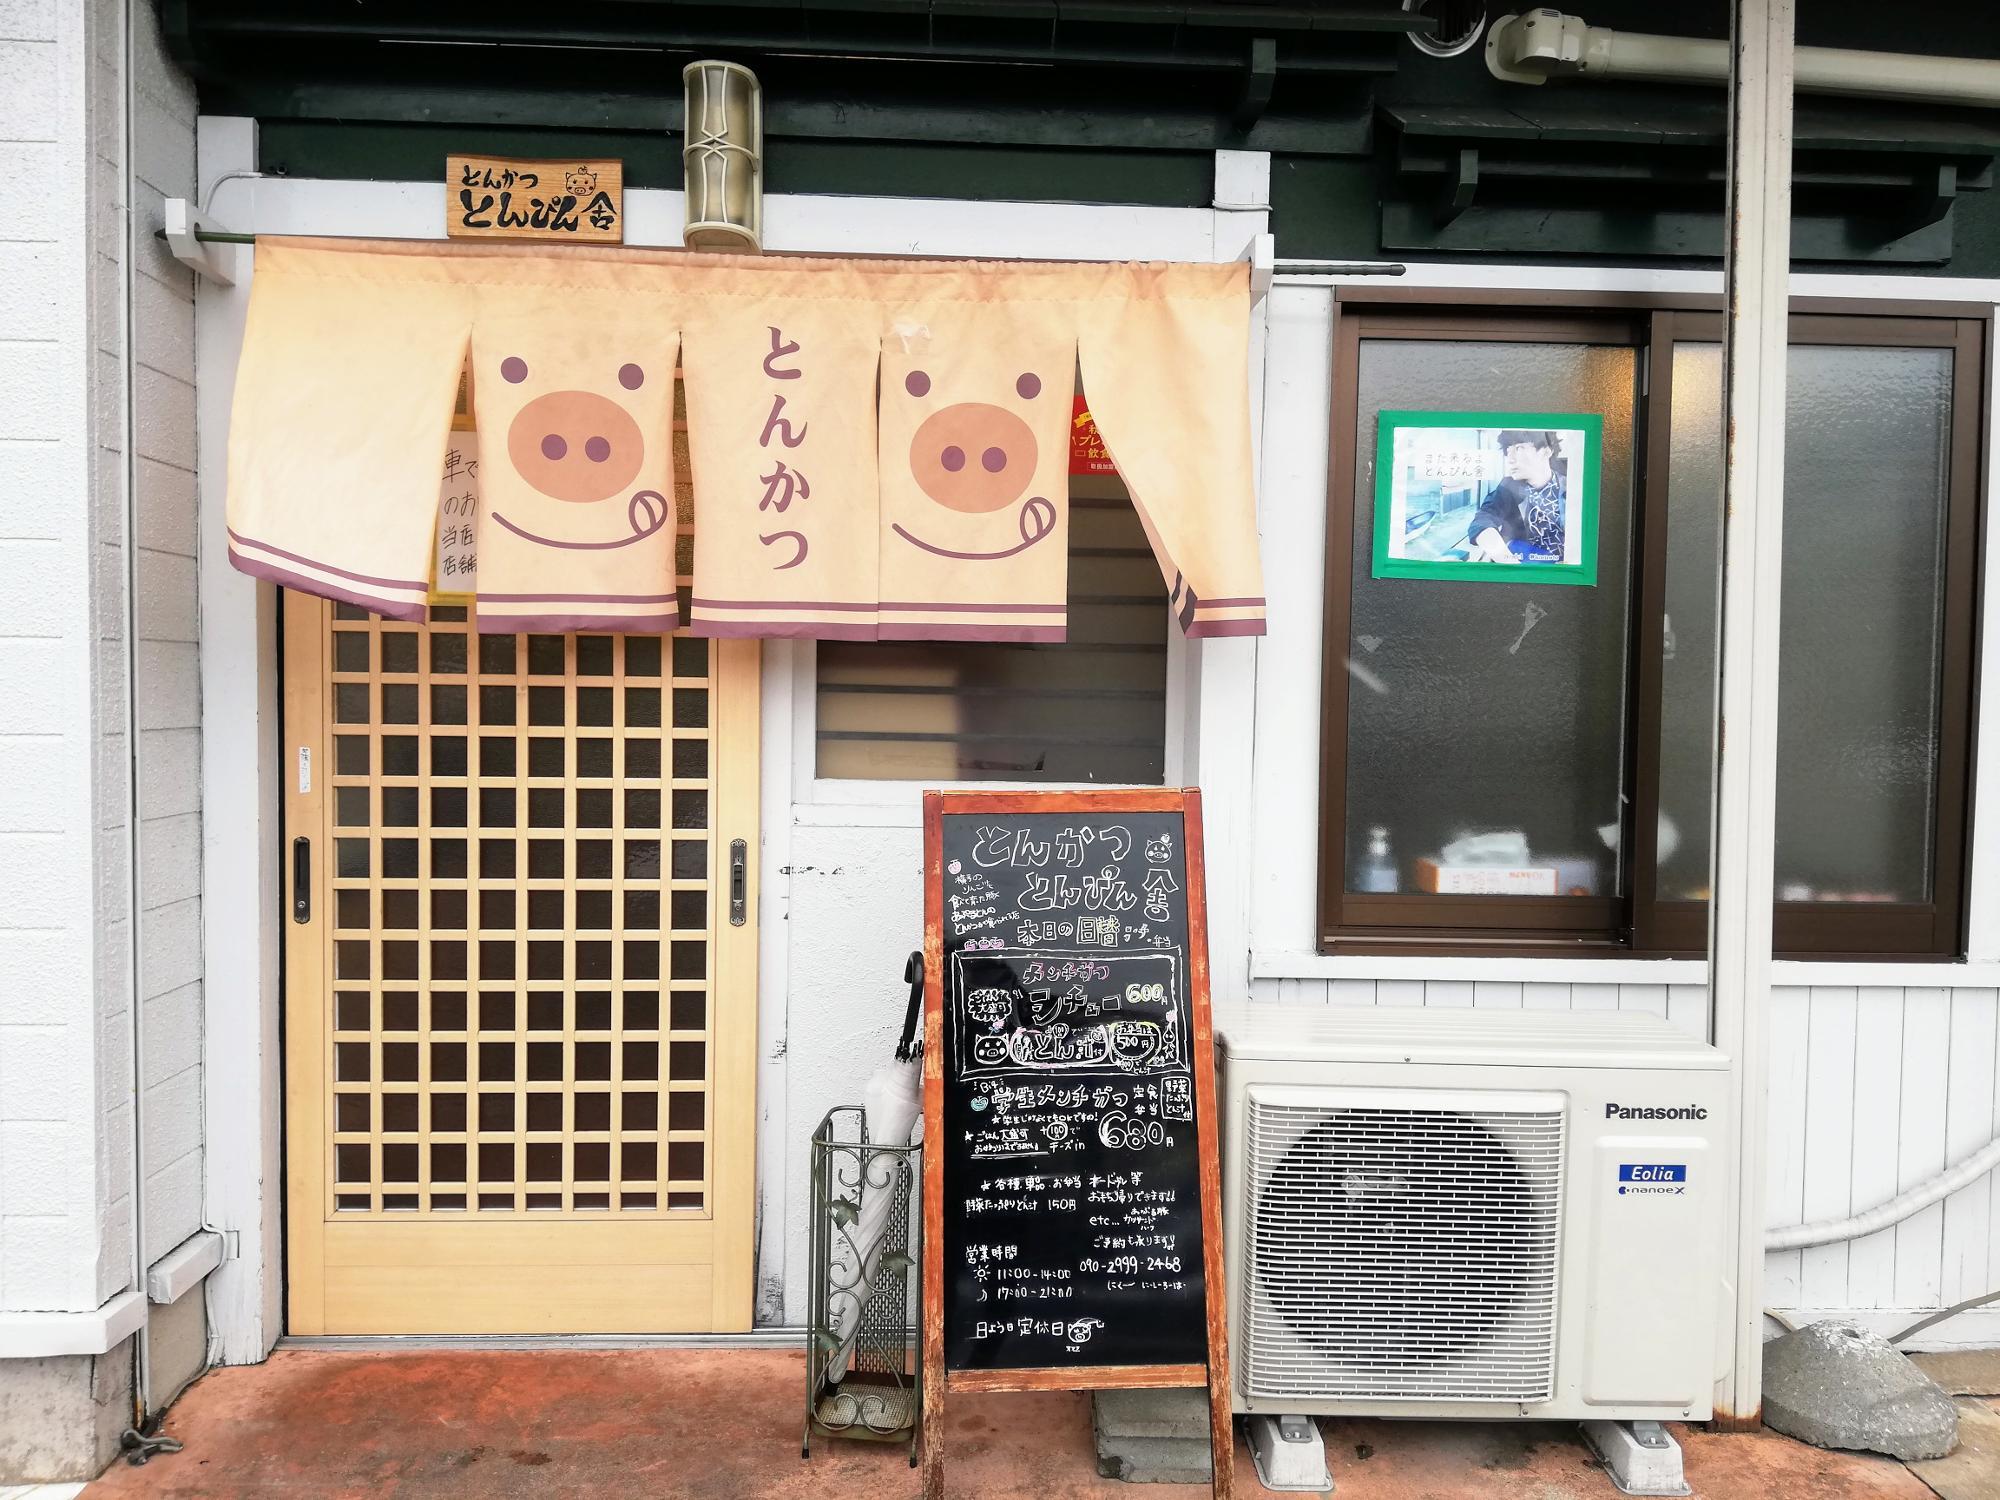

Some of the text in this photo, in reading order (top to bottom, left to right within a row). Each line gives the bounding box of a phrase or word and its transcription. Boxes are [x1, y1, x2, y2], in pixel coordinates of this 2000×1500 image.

[462, 165, 539, 189] とんかつ
[460, 189, 618, 231] とんぴん舎
[759, 326, 810, 570] とんかつ
[443, 491, 479, 517] のお
[1126, 984, 1168, 1006] 600円
[1133, 1084, 1158, 1101] 定食
[1165, 1079, 1187, 1093] 野菜
[1134, 1102, 1158, 1116] 弁当
[1605, 1102, 1708, 1120] Panasonic
[1631, 1166, 1675, 1181] Eolia
[1048, 1199, 1077, 1211] 150円
[966, 1245, 1018, 1264] 営業時間
